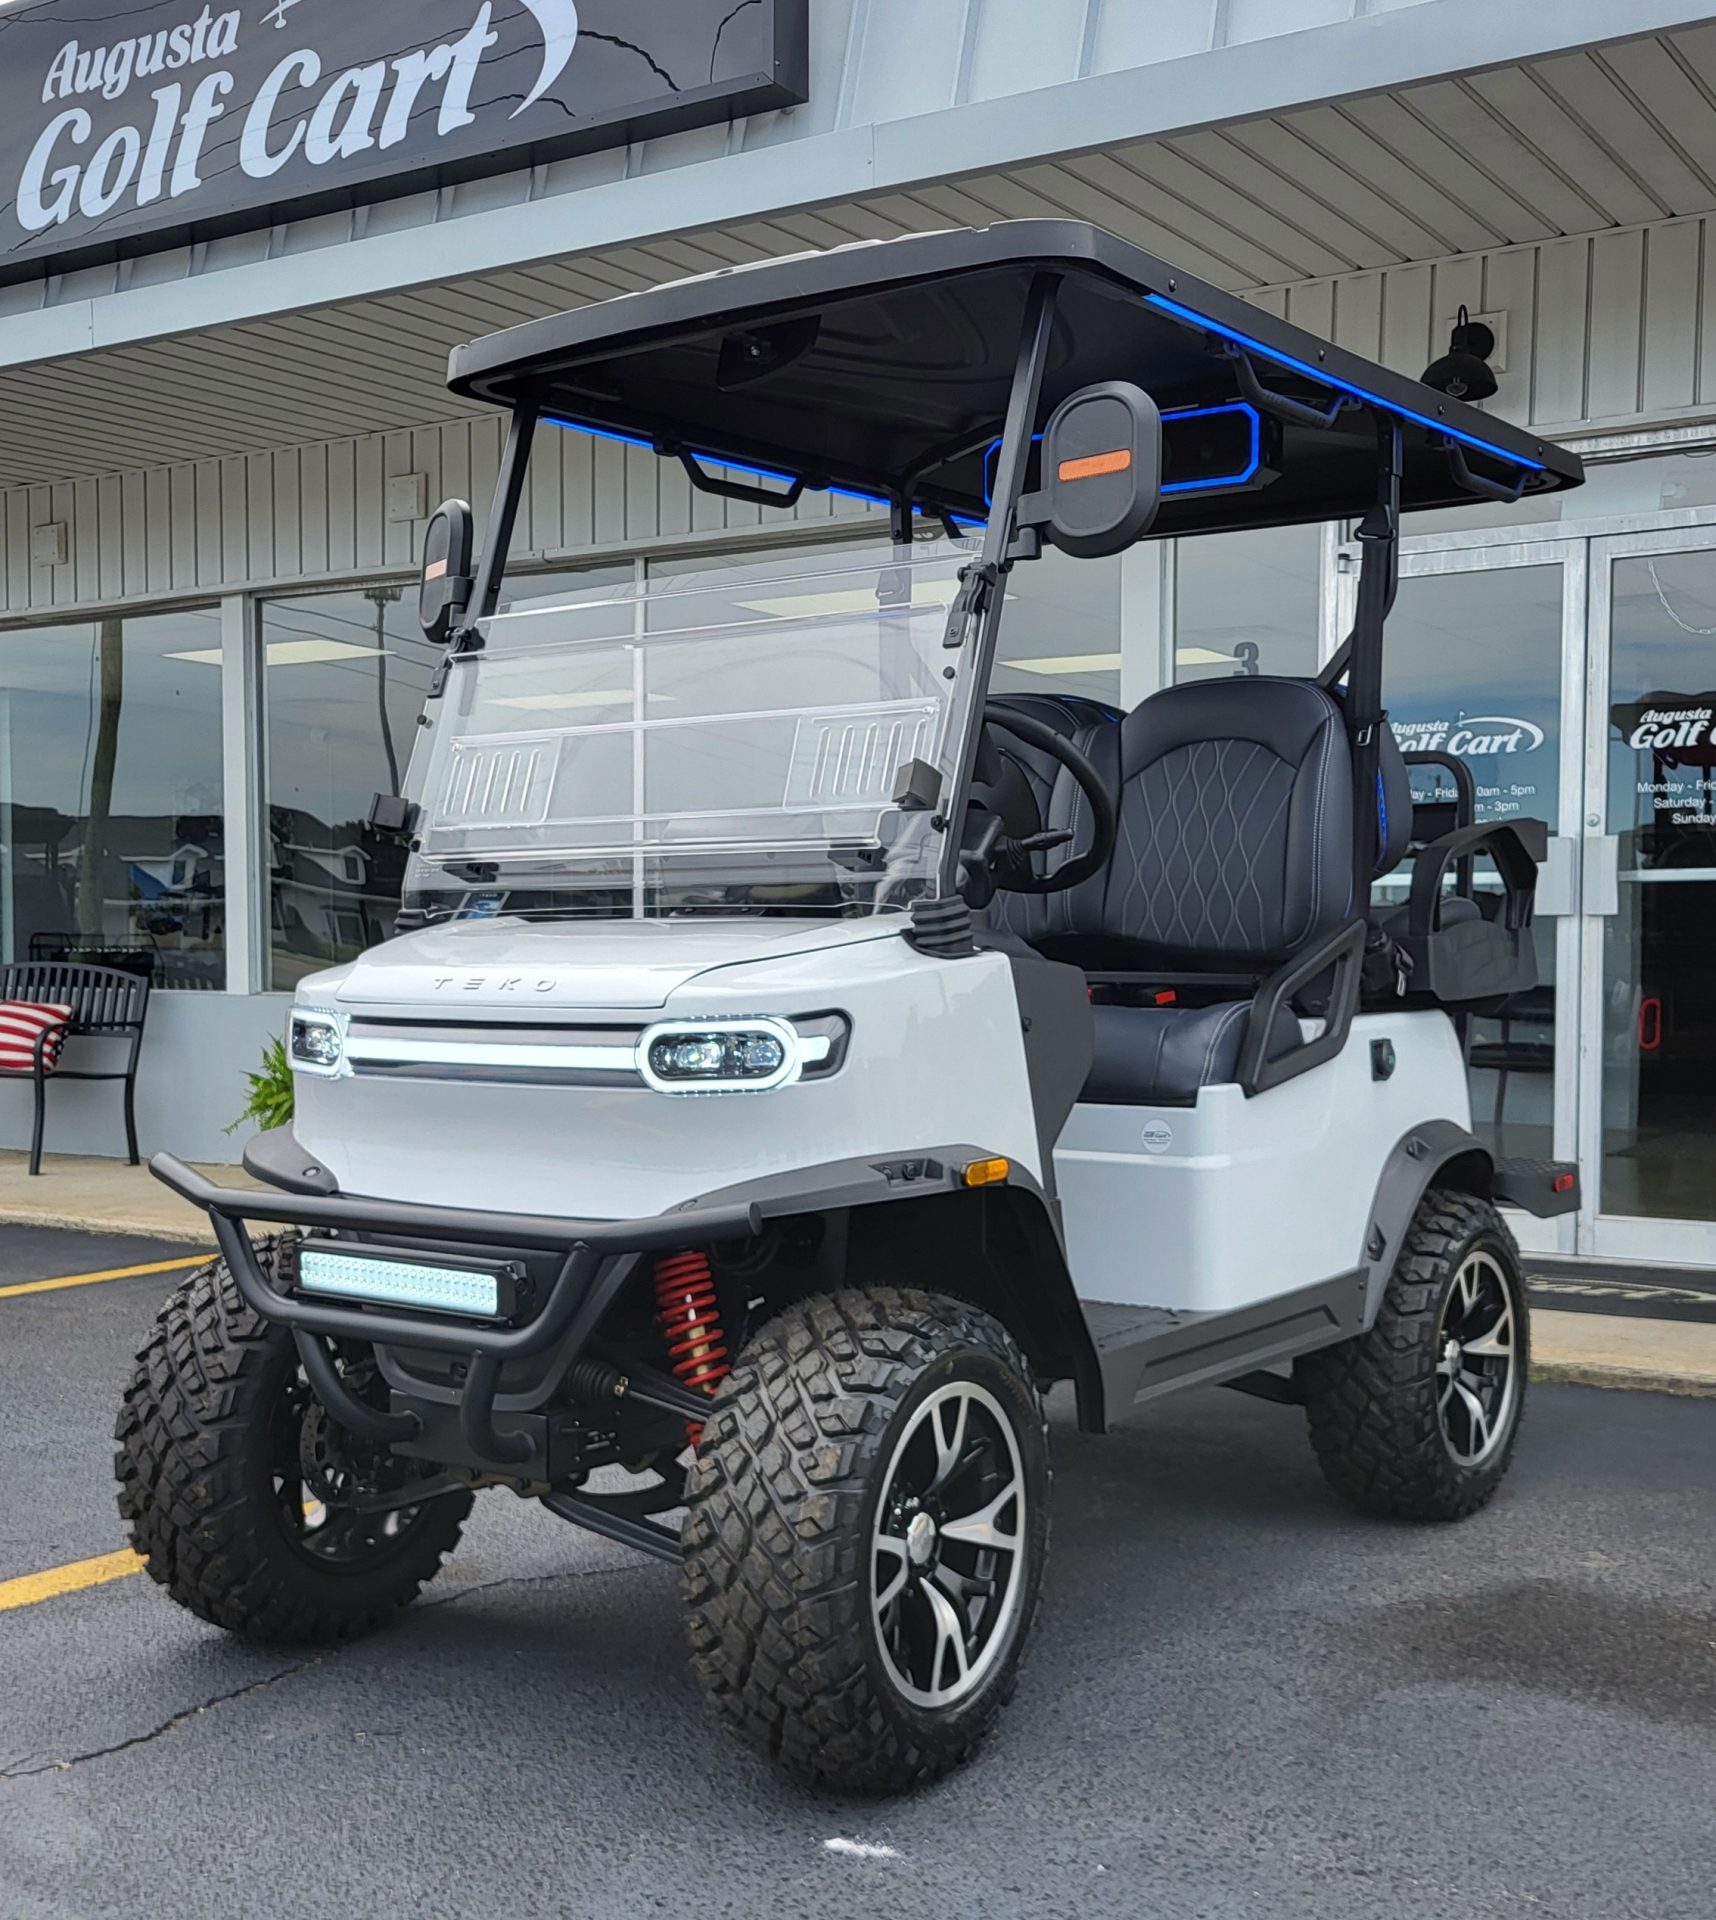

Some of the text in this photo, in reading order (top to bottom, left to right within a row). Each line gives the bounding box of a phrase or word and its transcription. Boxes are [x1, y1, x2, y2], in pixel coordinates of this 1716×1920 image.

[41, 4, 241, 104] Augusta
[15, 0, 499, 232] Golf Cart
[1640, 707, 1713, 725] Augusta
[1394, 728, 1524, 756] olf Cart
[1629, 720, 1710, 750] Golf
[1476, 786, 1500, 797] 0am
[1510, 784, 1536, 798] 5pm
[1637, 781, 1685, 793] Monday
[1494, 801, 1520, 813] 3pm
[1653, 796, 1706, 809] Saturday
[1672, 811, 1716, 825] Sunday
[434, 977, 558, 993] TEKO
